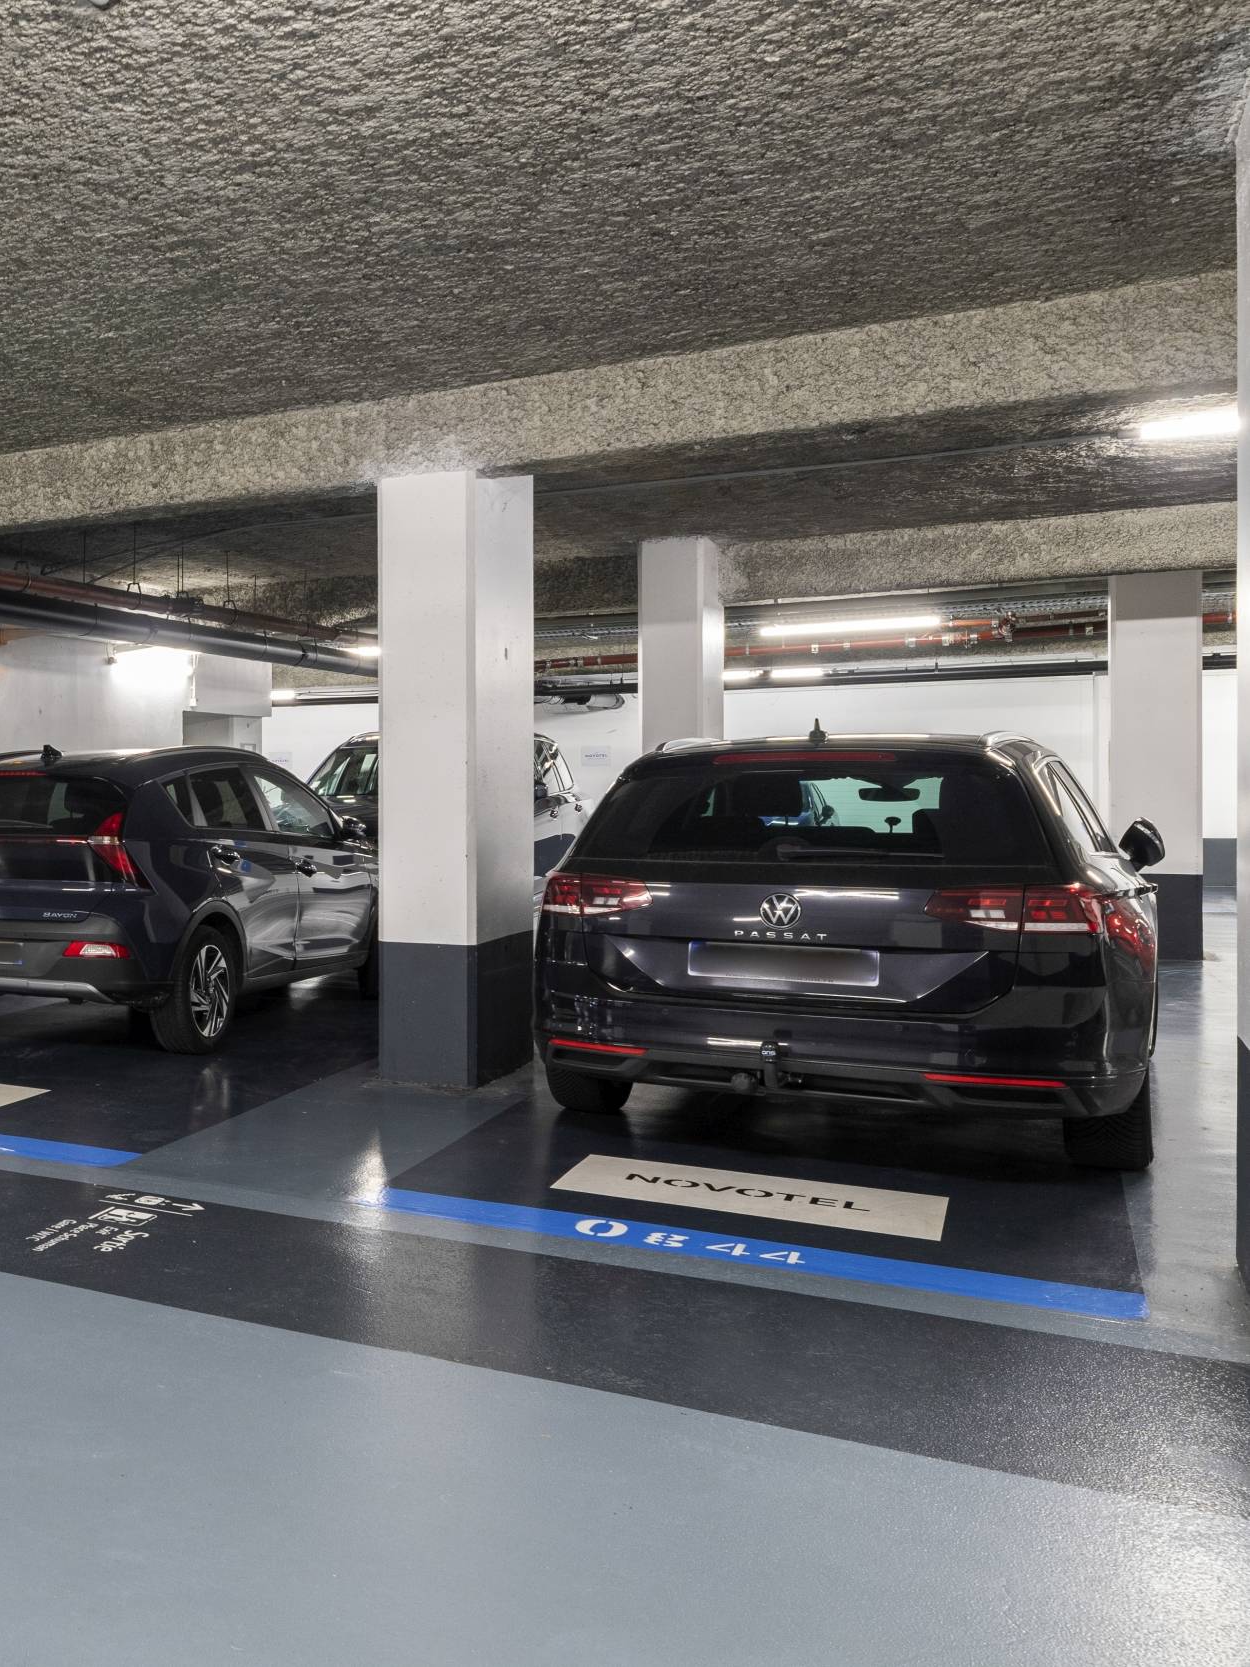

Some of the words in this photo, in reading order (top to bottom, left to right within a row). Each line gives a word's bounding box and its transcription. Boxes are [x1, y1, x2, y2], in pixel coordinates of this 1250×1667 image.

[42, 911, 78, 919] BAYON
[734, 930, 827, 941] PASSAT
[625, 1173, 871, 1212] NOVOTEL
[93, 1229, 150, 1252] Sortie
[574, 1219, 806, 1264] 0844
